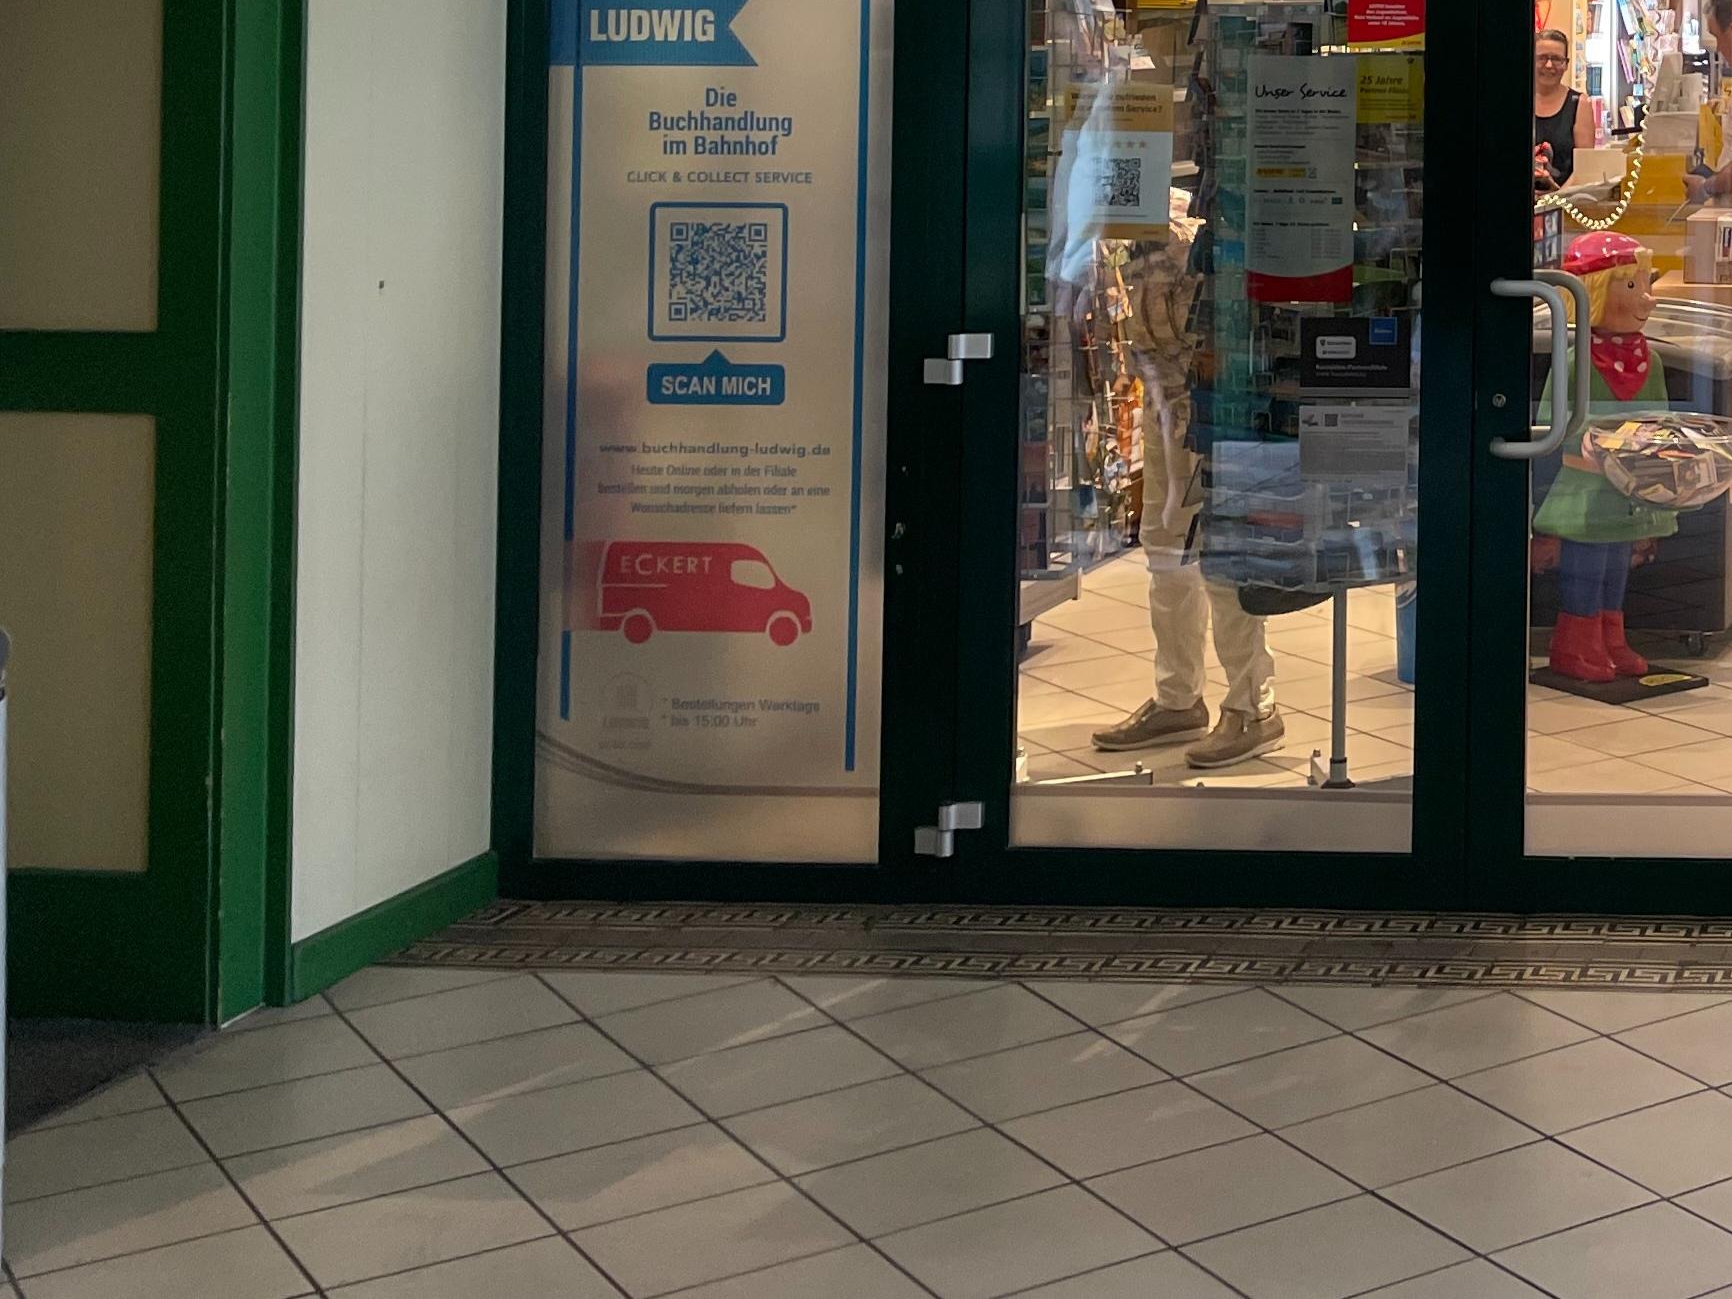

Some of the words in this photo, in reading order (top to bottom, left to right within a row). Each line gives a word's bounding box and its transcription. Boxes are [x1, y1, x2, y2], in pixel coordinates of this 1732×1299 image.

[590, 9, 715, 42] LUDWIG
[705, 87, 737, 107] Die
[1255, 84, 1294, 100] Unser
[1300, 83, 1348, 99] Service
[649, 111, 792, 136] Buchhandlung
[663, 135, 687, 156] im
[694, 135, 778, 156] Bahnhof
[627, 171, 667, 183] CLICK
[673, 171, 681, 183] &
[687, 171, 749, 183] COLLECT
[755, 172, 813, 184] SERVICE
[661, 376, 717, 395] SCAN
[722, 377, 771, 395] MICH
[600, 442, 831, 458] www.buchhandlung-ludwig.de
[621, 553, 713, 576] ECKERT
